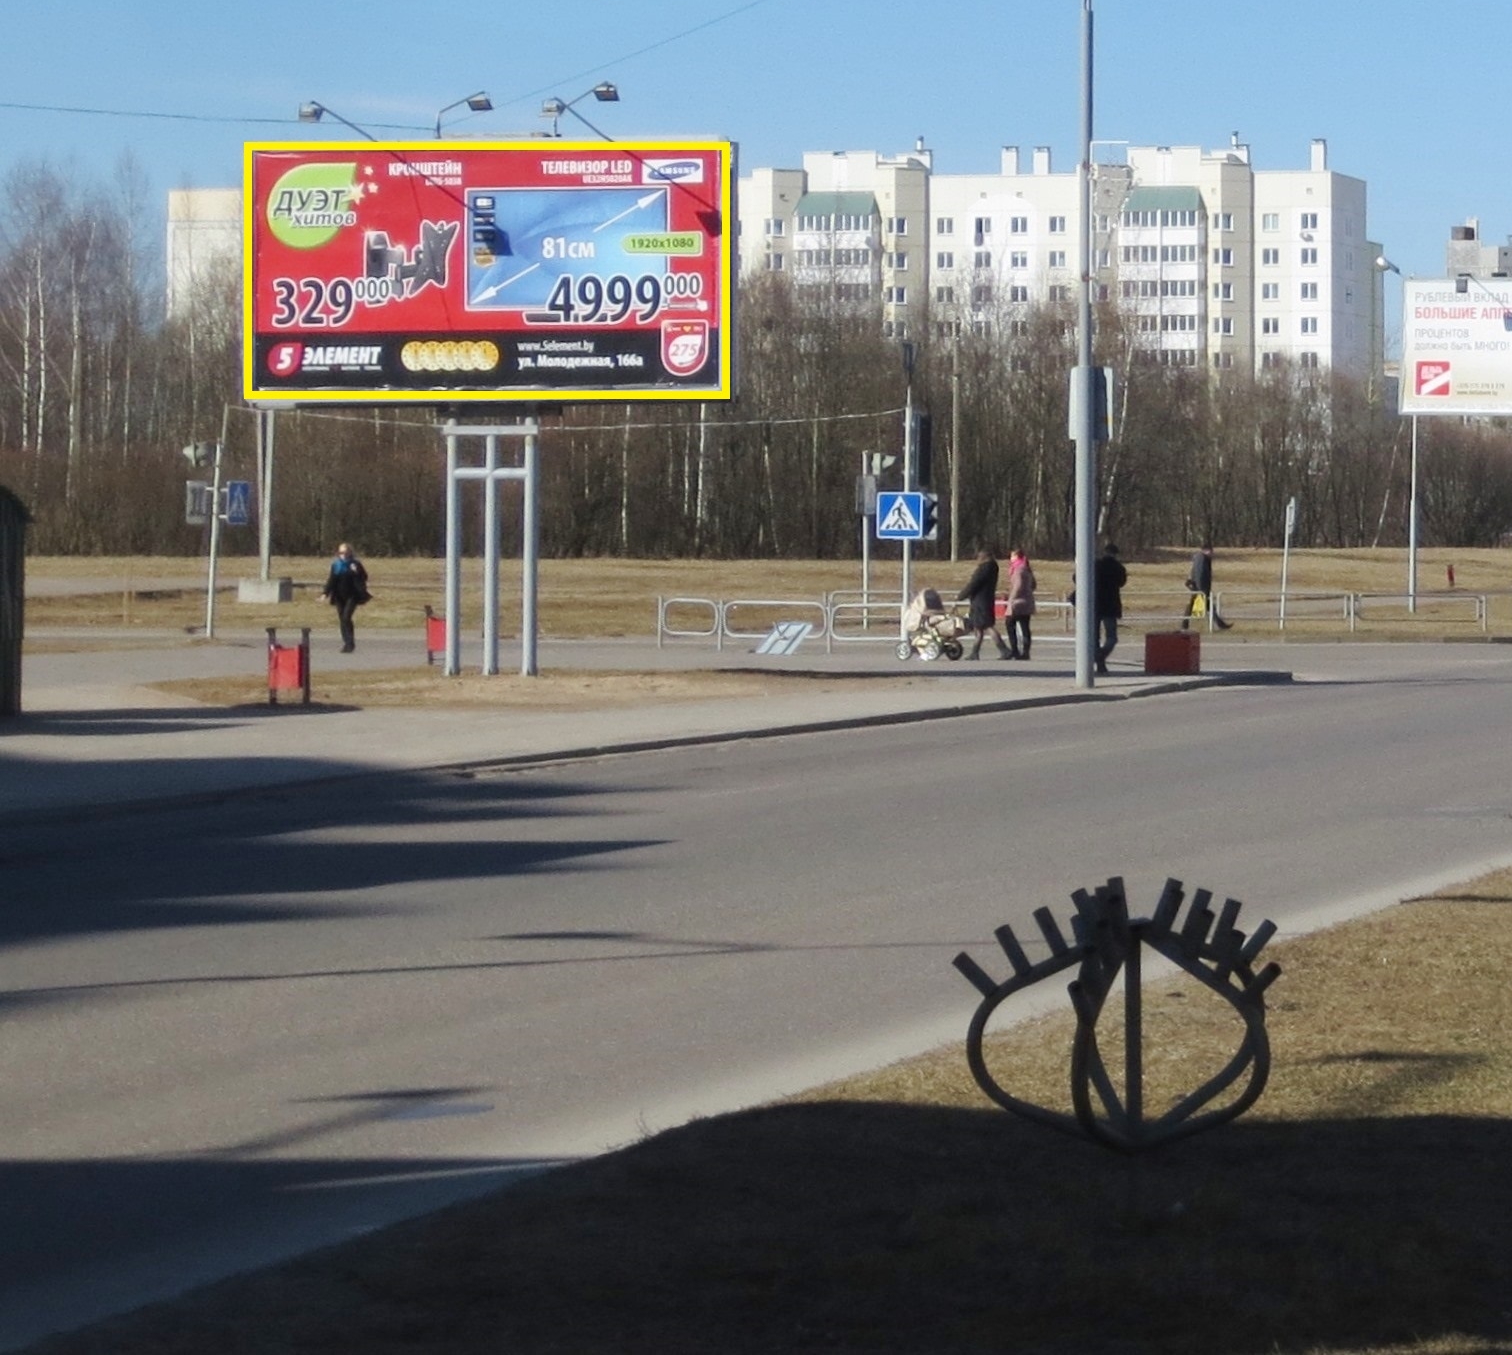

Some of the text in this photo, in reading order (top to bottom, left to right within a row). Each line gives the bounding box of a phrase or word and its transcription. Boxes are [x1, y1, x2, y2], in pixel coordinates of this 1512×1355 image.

[388, 160, 462, 176] КРОНШТЕЙН
[541, 159, 633, 175] ТЕЛЕВИЗОР LED
[273, 189, 346, 218] ДУЭТ
[292, 212, 357, 226] хитов
[542, 237, 595, 258] 81см
[631, 238, 694, 249] 1920x1080
[273, 279, 353, 325] 329
[548, 275, 661, 323] 4999
[1474, 292, 1509, 304] ВКЛАД
[1414, 306, 1477, 320] БОЛЬШИЕ
[1414, 328, 1470, 339] ПРОЦЕНТОВ
[276, 346, 382, 370] 5 ЭЛЕМЕНТ
[671, 343, 699, 357] 275
[518, 356, 535, 370] ул.
[536, 354, 615, 369] Молодежная,
